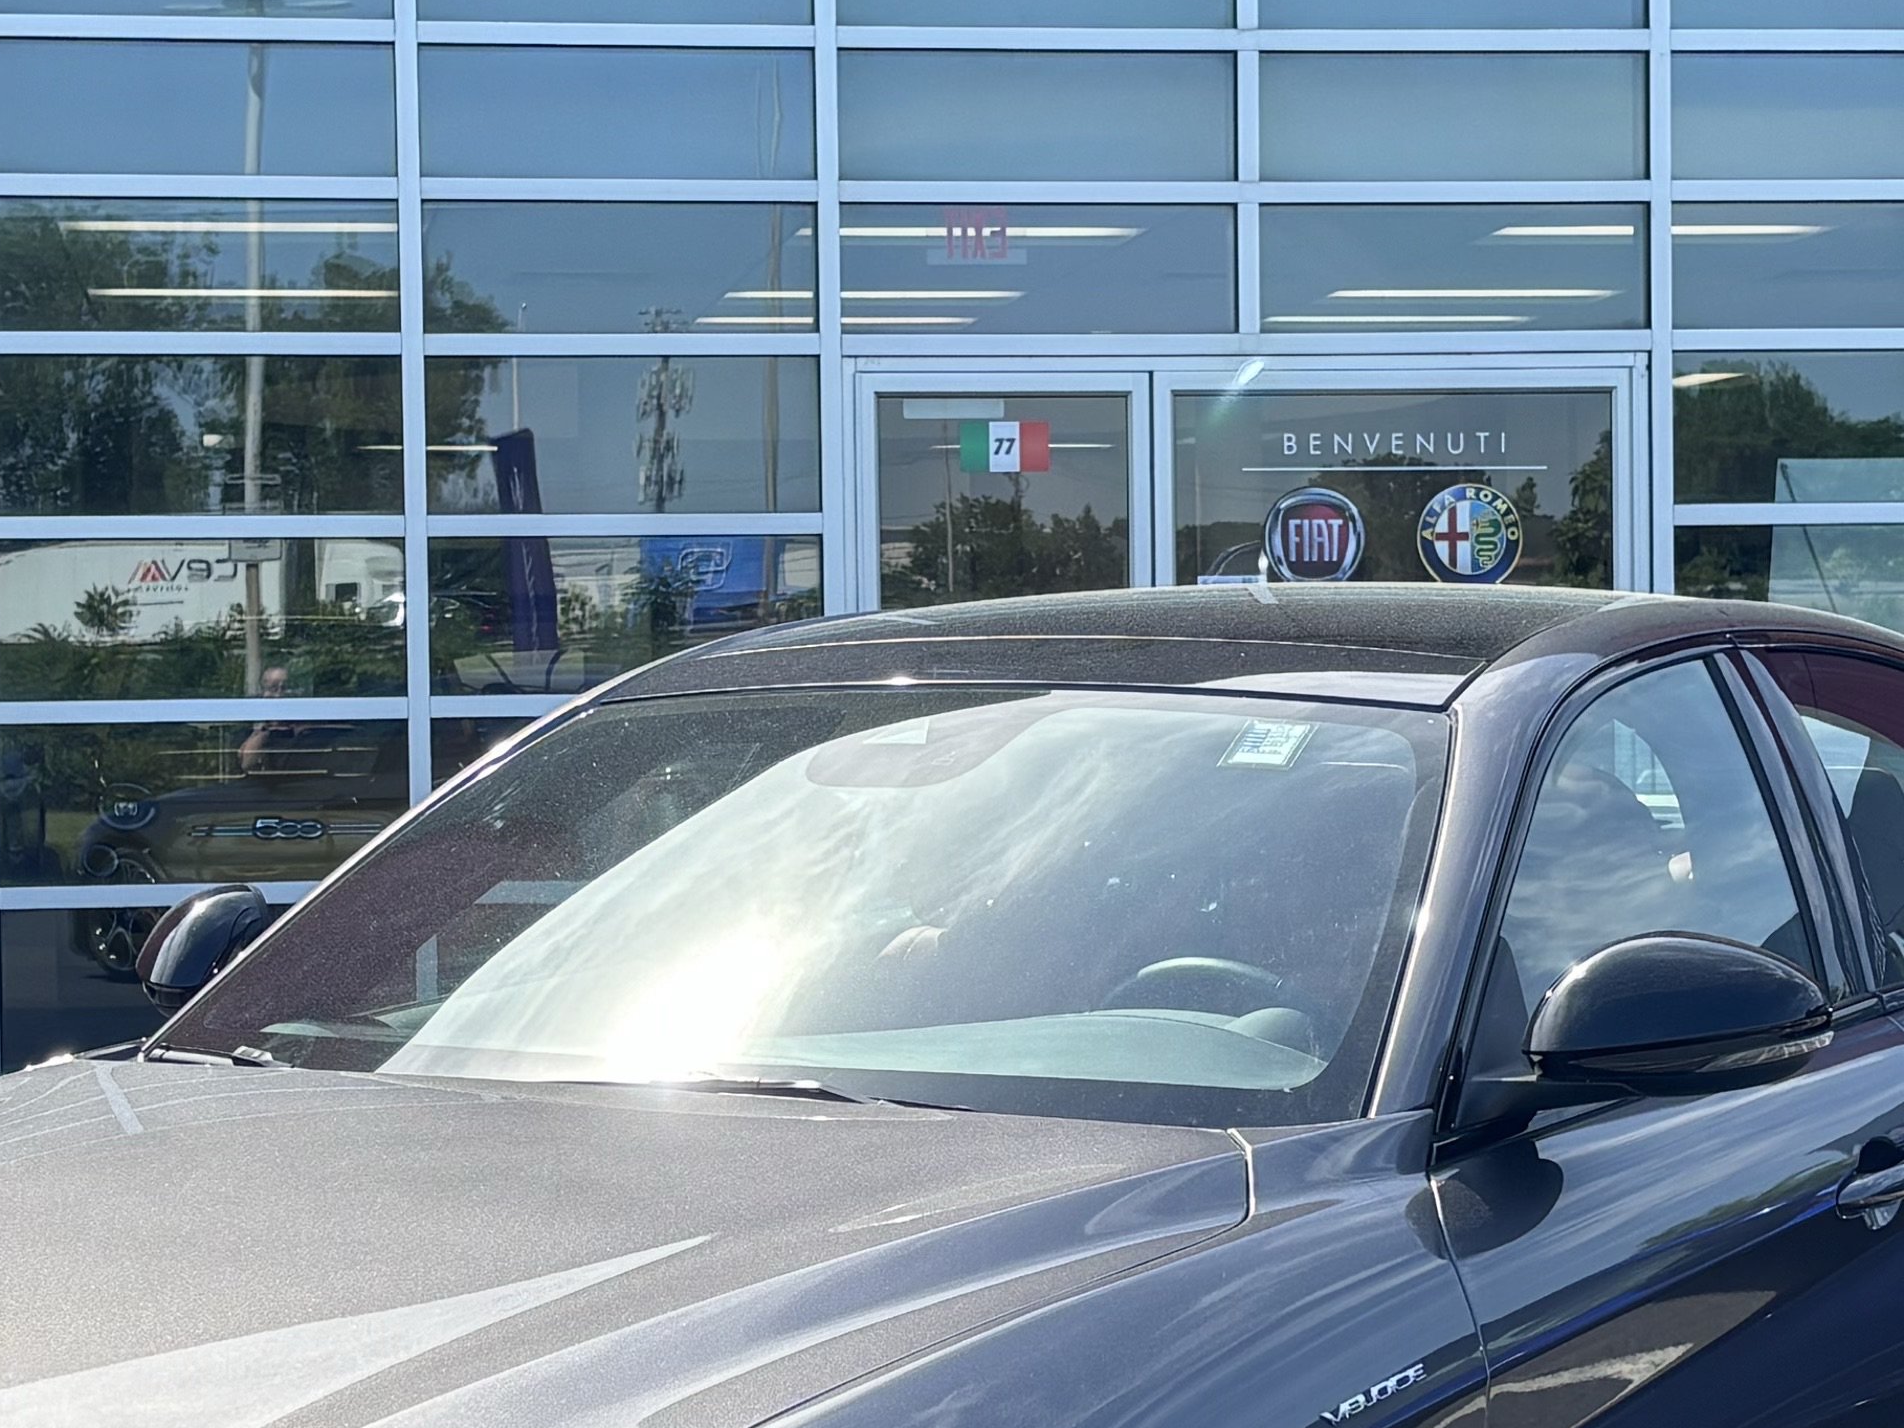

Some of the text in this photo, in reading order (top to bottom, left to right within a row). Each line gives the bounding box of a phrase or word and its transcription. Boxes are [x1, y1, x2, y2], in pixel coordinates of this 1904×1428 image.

[993, 437, 1016, 456] 77
[1283, 432, 1506, 455] BENVENUTI
[1421, 487, 1519, 542] ALFA ROMEO
[1287, 518, 1344, 562] FIAT
